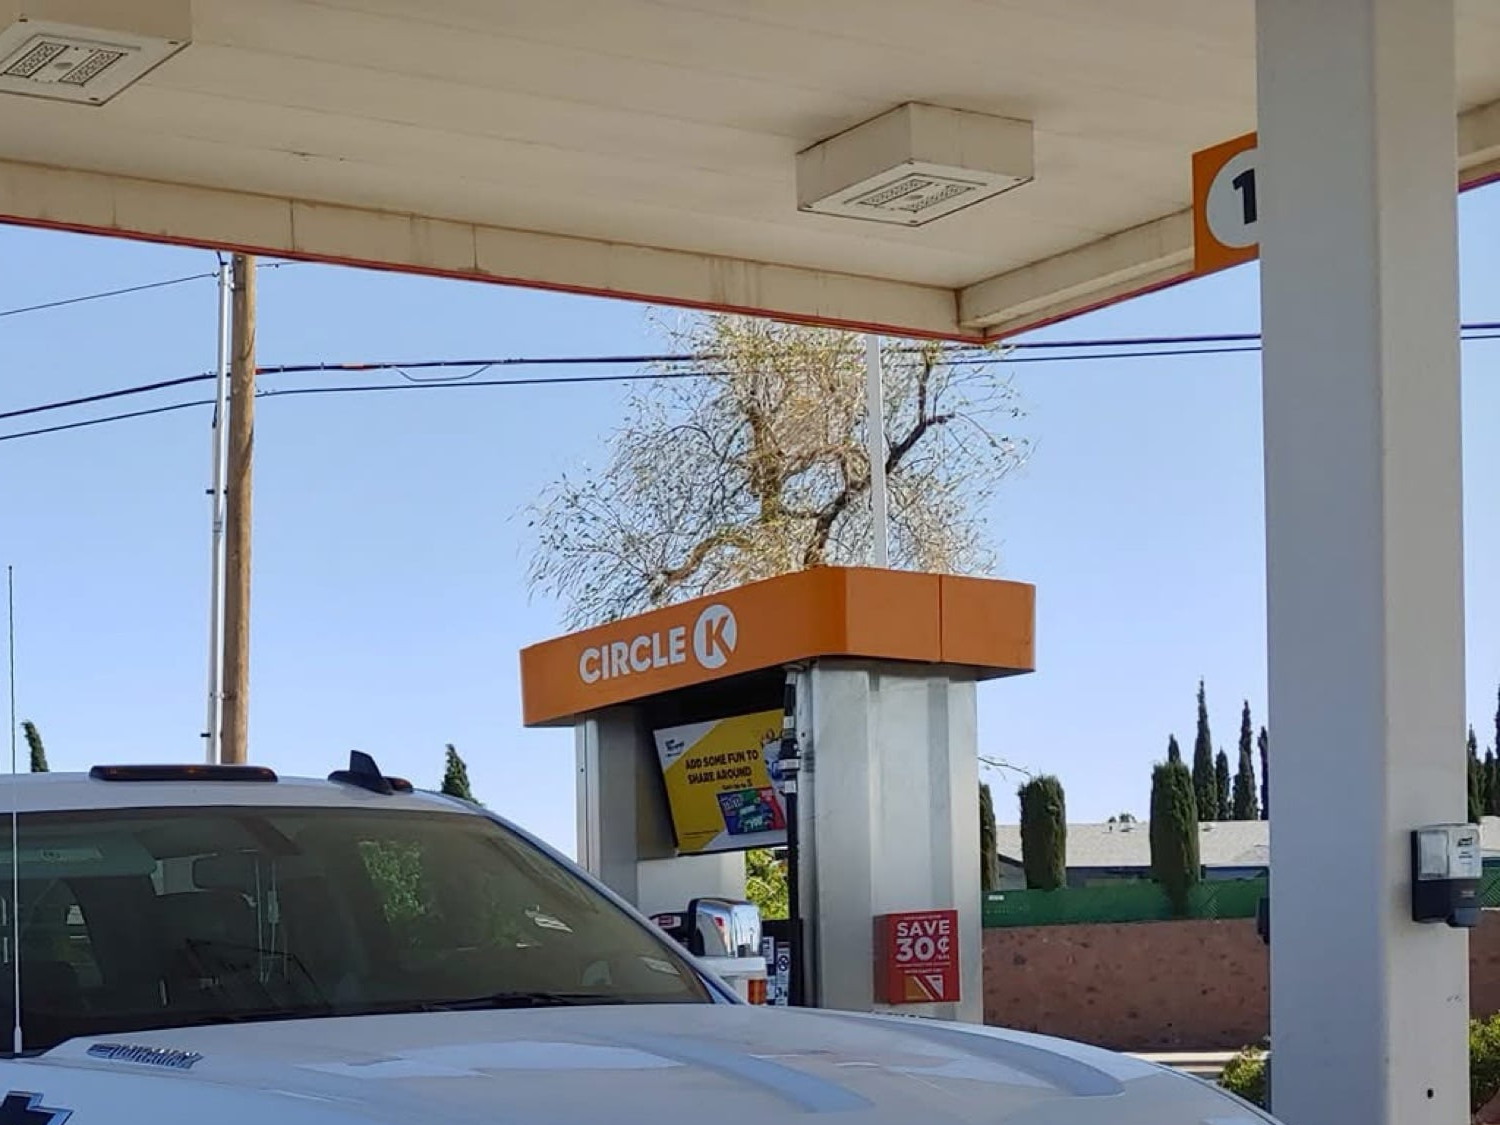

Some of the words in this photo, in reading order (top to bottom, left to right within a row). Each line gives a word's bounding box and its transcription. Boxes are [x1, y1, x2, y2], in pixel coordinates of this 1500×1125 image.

[579, 626, 686, 684] CIRCLE
[698, 608, 736, 665] K
[703, 754, 726, 767] SOME
[728, 750, 745, 764] FUN
[747, 749, 759, 761] TO
[687, 771, 715, 784] SHARE
[716, 766, 752, 782] AROUND
[897, 920, 950, 937] SAVE
[896, 936, 950, 962] 30¢
